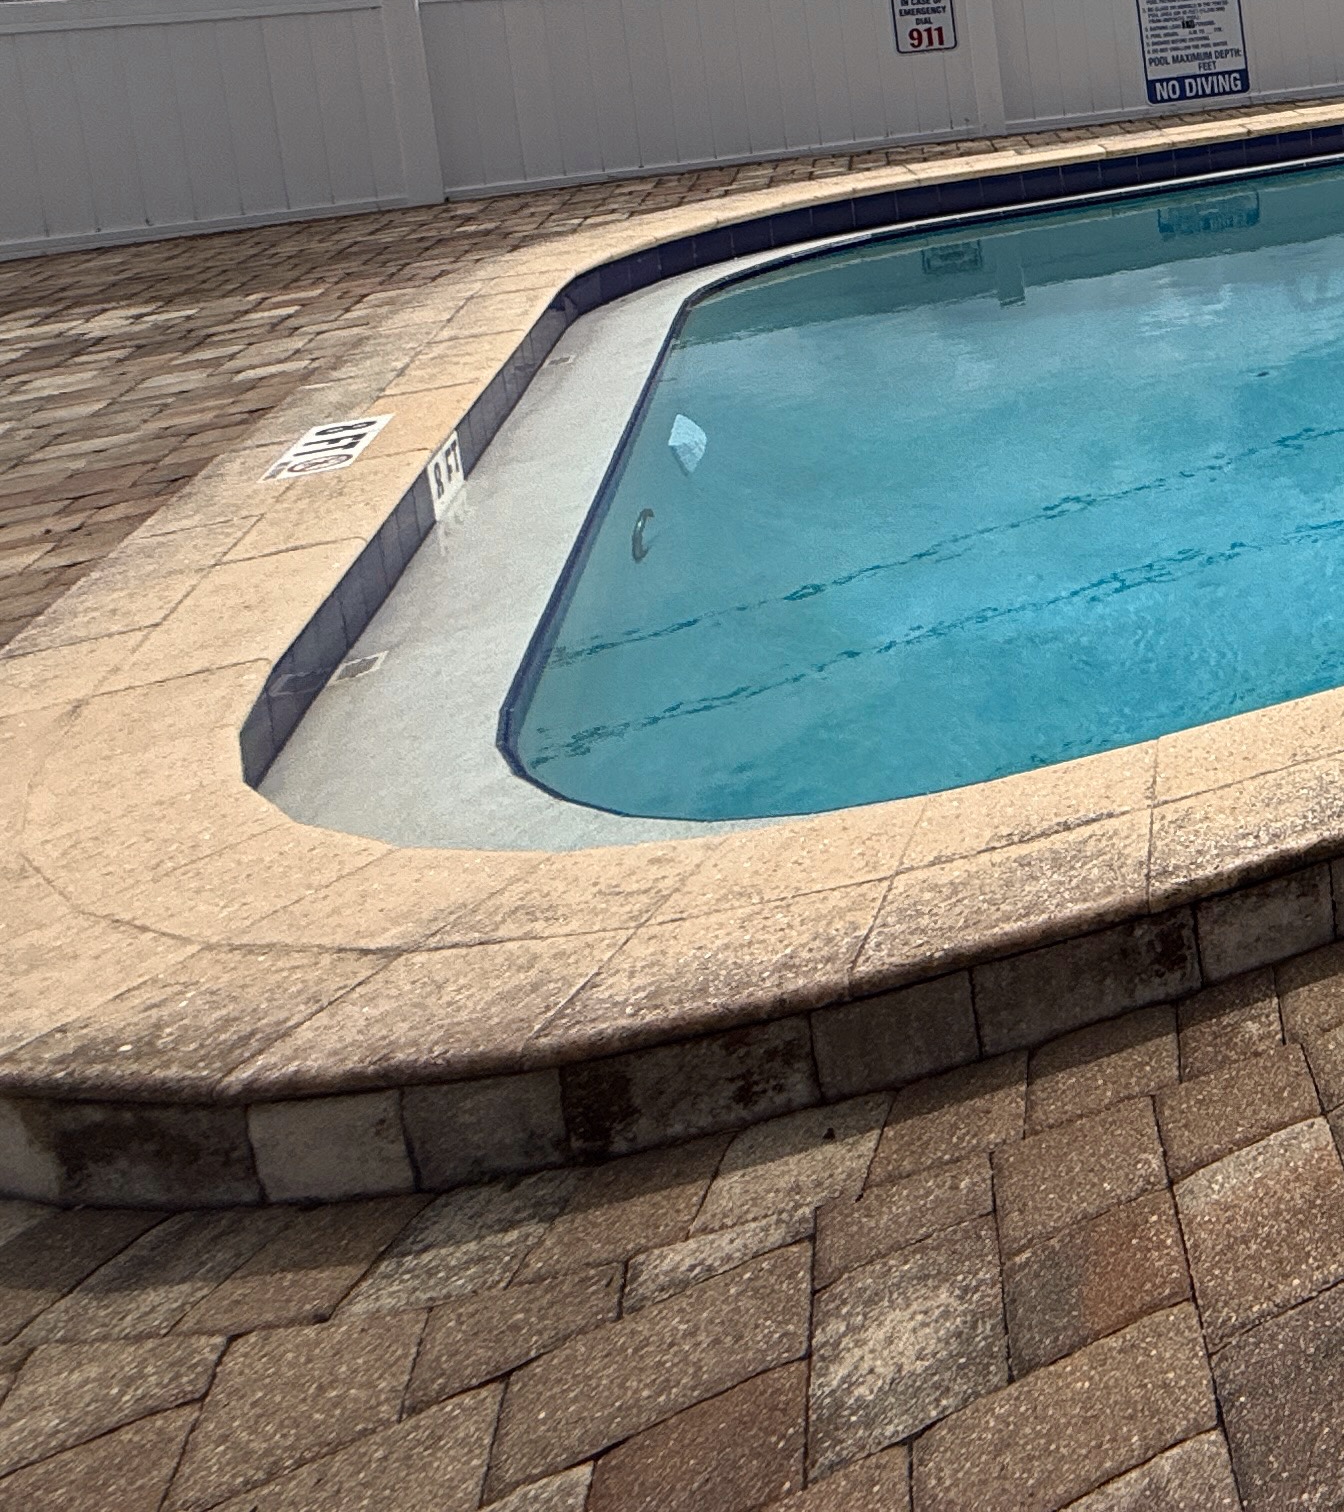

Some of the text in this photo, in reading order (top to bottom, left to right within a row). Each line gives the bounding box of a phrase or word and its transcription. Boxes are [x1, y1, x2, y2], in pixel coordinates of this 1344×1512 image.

[899, 6, 946, 17] EMERGENCY
[915, 17, 933, 26] DIAL
[908, 26, 945, 49] 911
[1148, 55, 1170, 67] POOL
[1171, 50, 1213, 64] MAXIMUM
[1198, 61, 1217, 72] FEET
[1155, 72, 1242, 101] NO DIVING
[293, 420, 377, 456] 8 FT
[444, 439, 461, 484] FT
